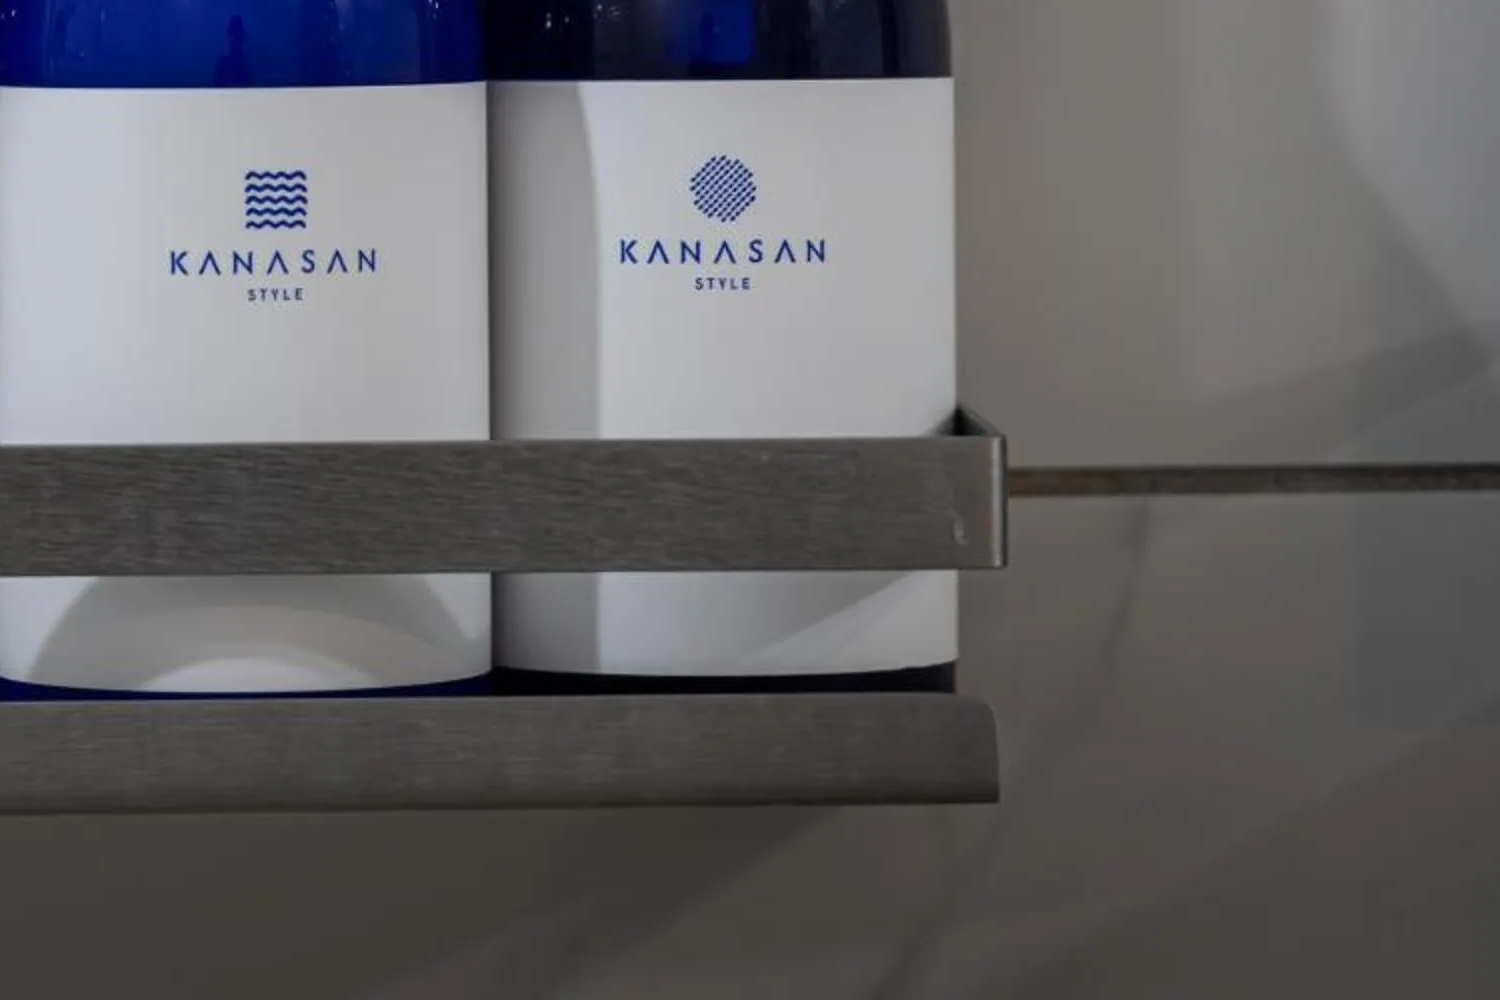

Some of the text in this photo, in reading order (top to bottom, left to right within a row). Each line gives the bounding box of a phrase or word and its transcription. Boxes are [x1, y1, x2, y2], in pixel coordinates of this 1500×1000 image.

[619, 239, 826, 265] KANASAN
[169, 249, 378, 276] KANASAN
[246, 287, 303, 302] STYLE
[695, 277, 751, 292] STYLE
